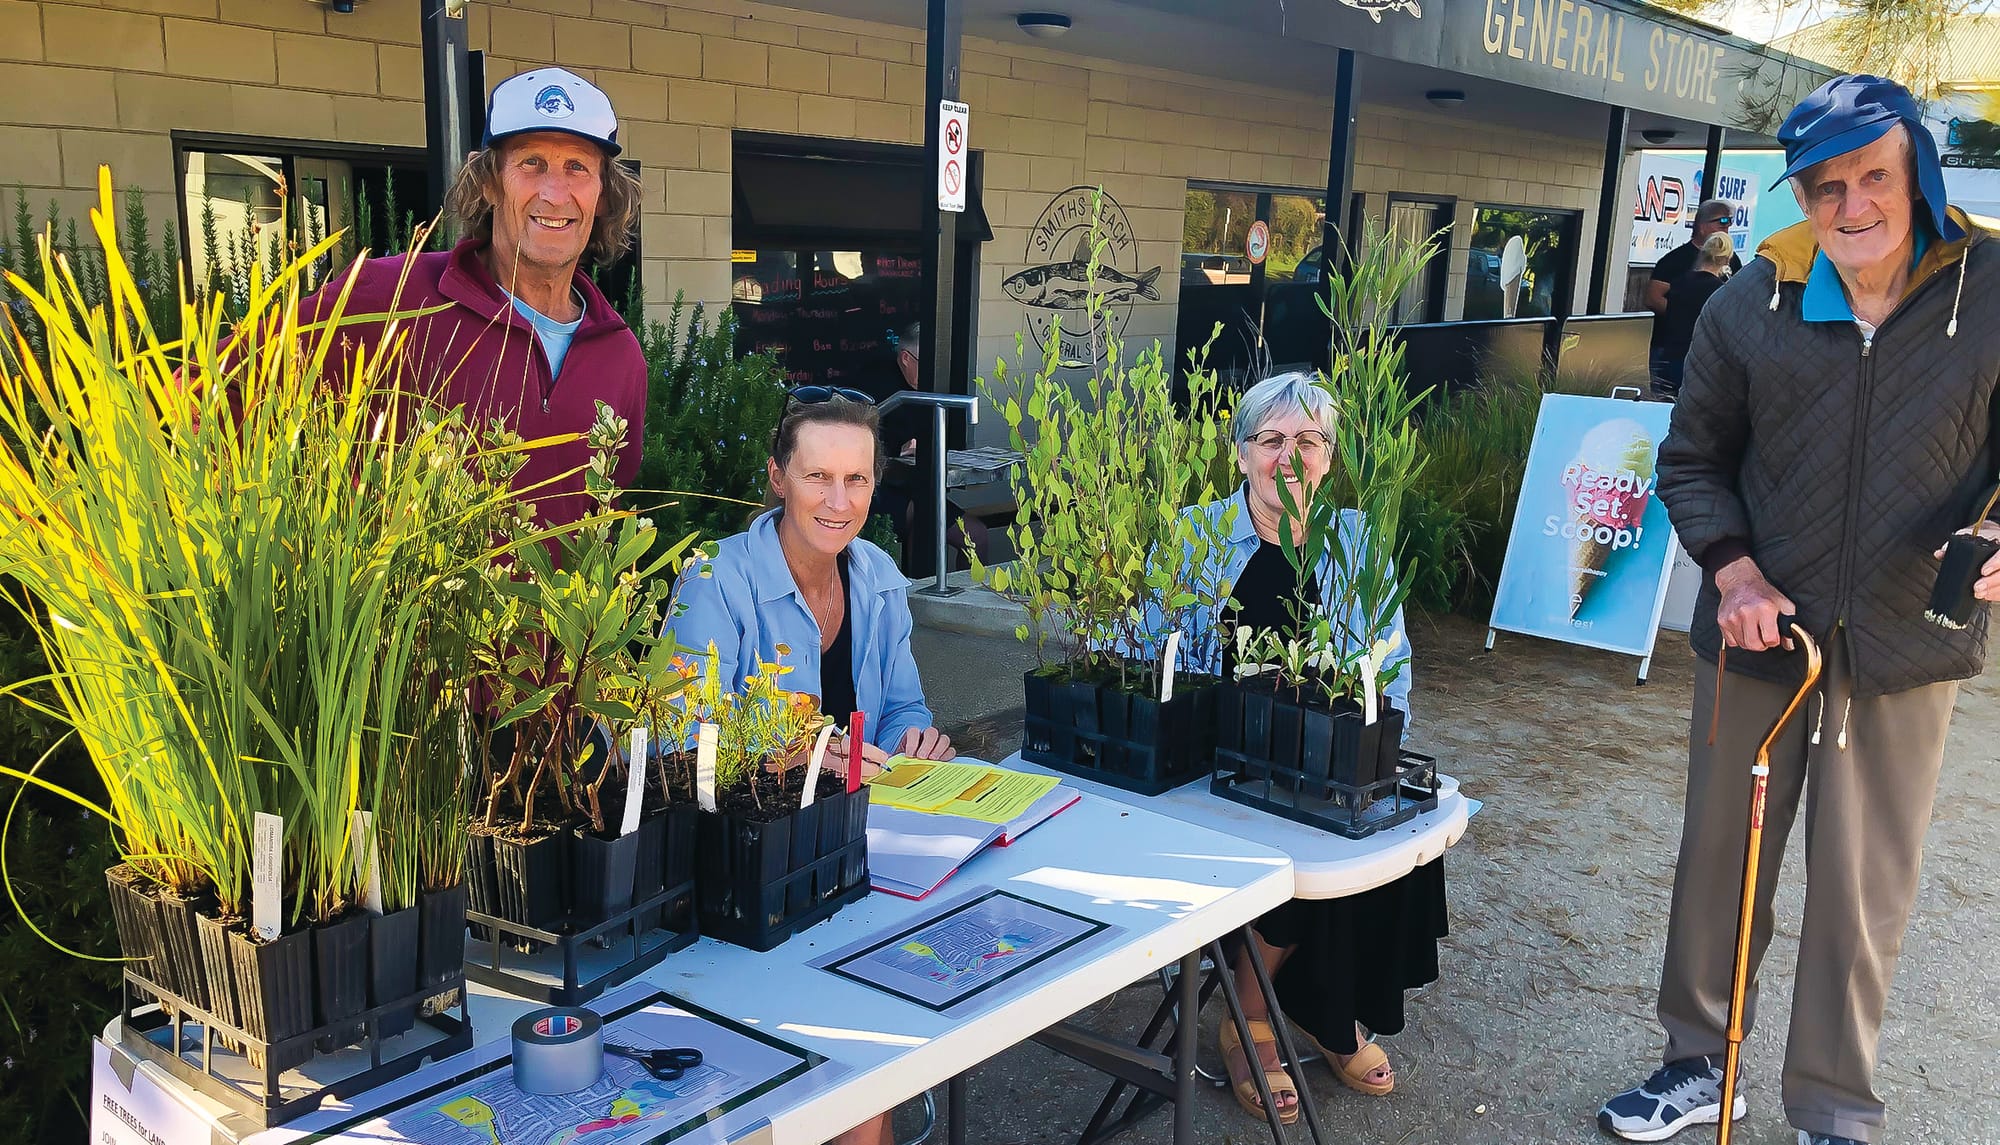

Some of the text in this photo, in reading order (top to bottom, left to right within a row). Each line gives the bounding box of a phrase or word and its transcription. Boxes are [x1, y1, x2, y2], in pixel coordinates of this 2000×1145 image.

[1483, 0, 1725, 104] GENERAL STORE
[1718, 176, 1746, 200] SURF
[1036, 197, 1130, 252] SMITHS EACH
[1561, 463, 1655, 499] Ready.
[1575, 491, 1628, 520] Set.
[1542, 514, 1644, 551] Scoop!
[103, 1094, 119, 1114] FREE
[119, 1107, 138, 1129] TREES
[138, 1122, 148, 1138] for
